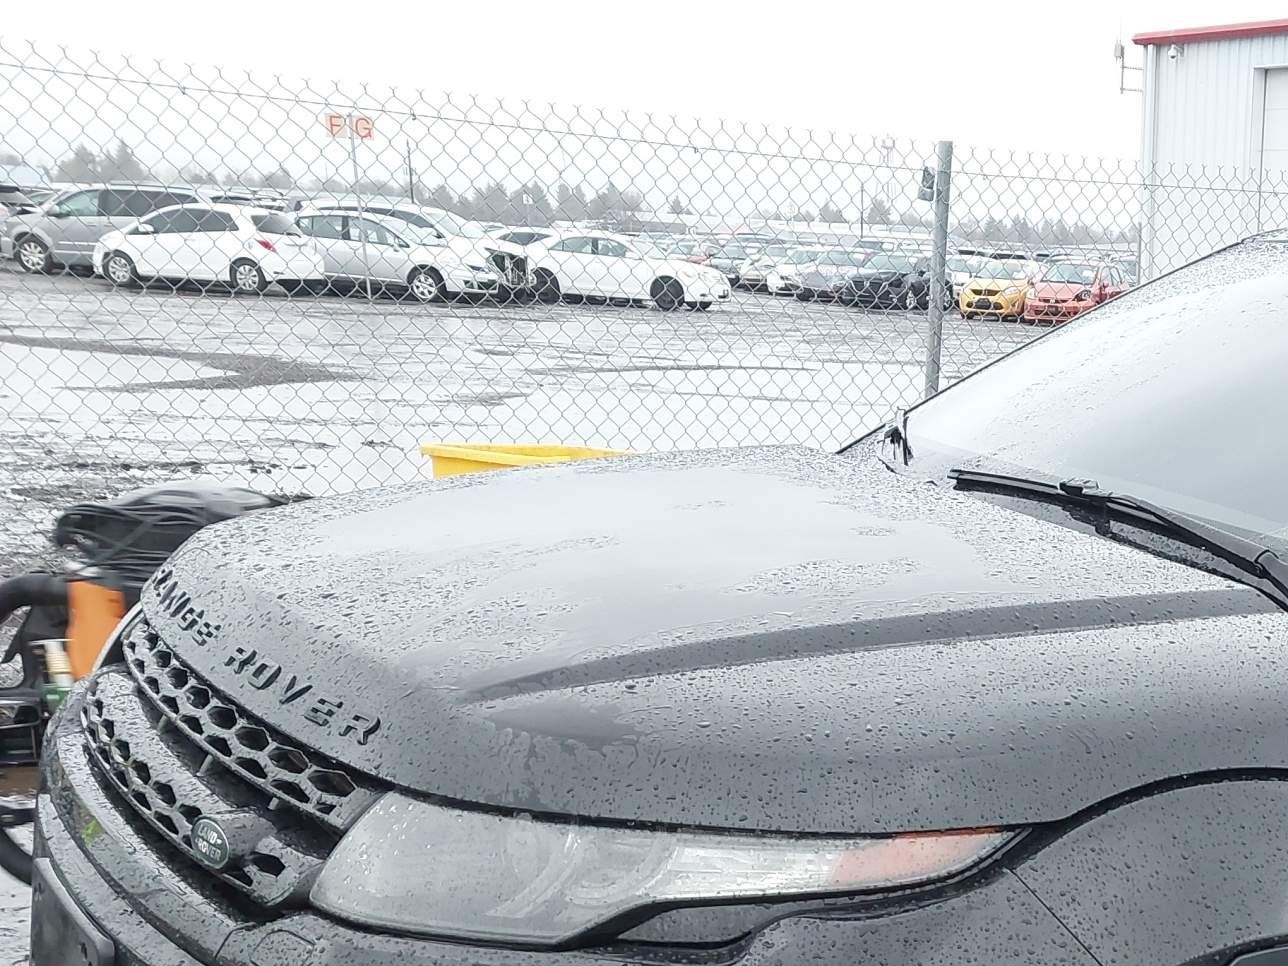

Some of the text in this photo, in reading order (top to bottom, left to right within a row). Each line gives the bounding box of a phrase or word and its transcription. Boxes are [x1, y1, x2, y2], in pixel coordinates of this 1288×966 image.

[329, 115, 342, 136] F
[355, 117, 372, 138] G
[152, 569, 382, 746] RANGE ROVER
[197, 823, 218, 845] LAND
[197, 838, 222, 861] ROVER
